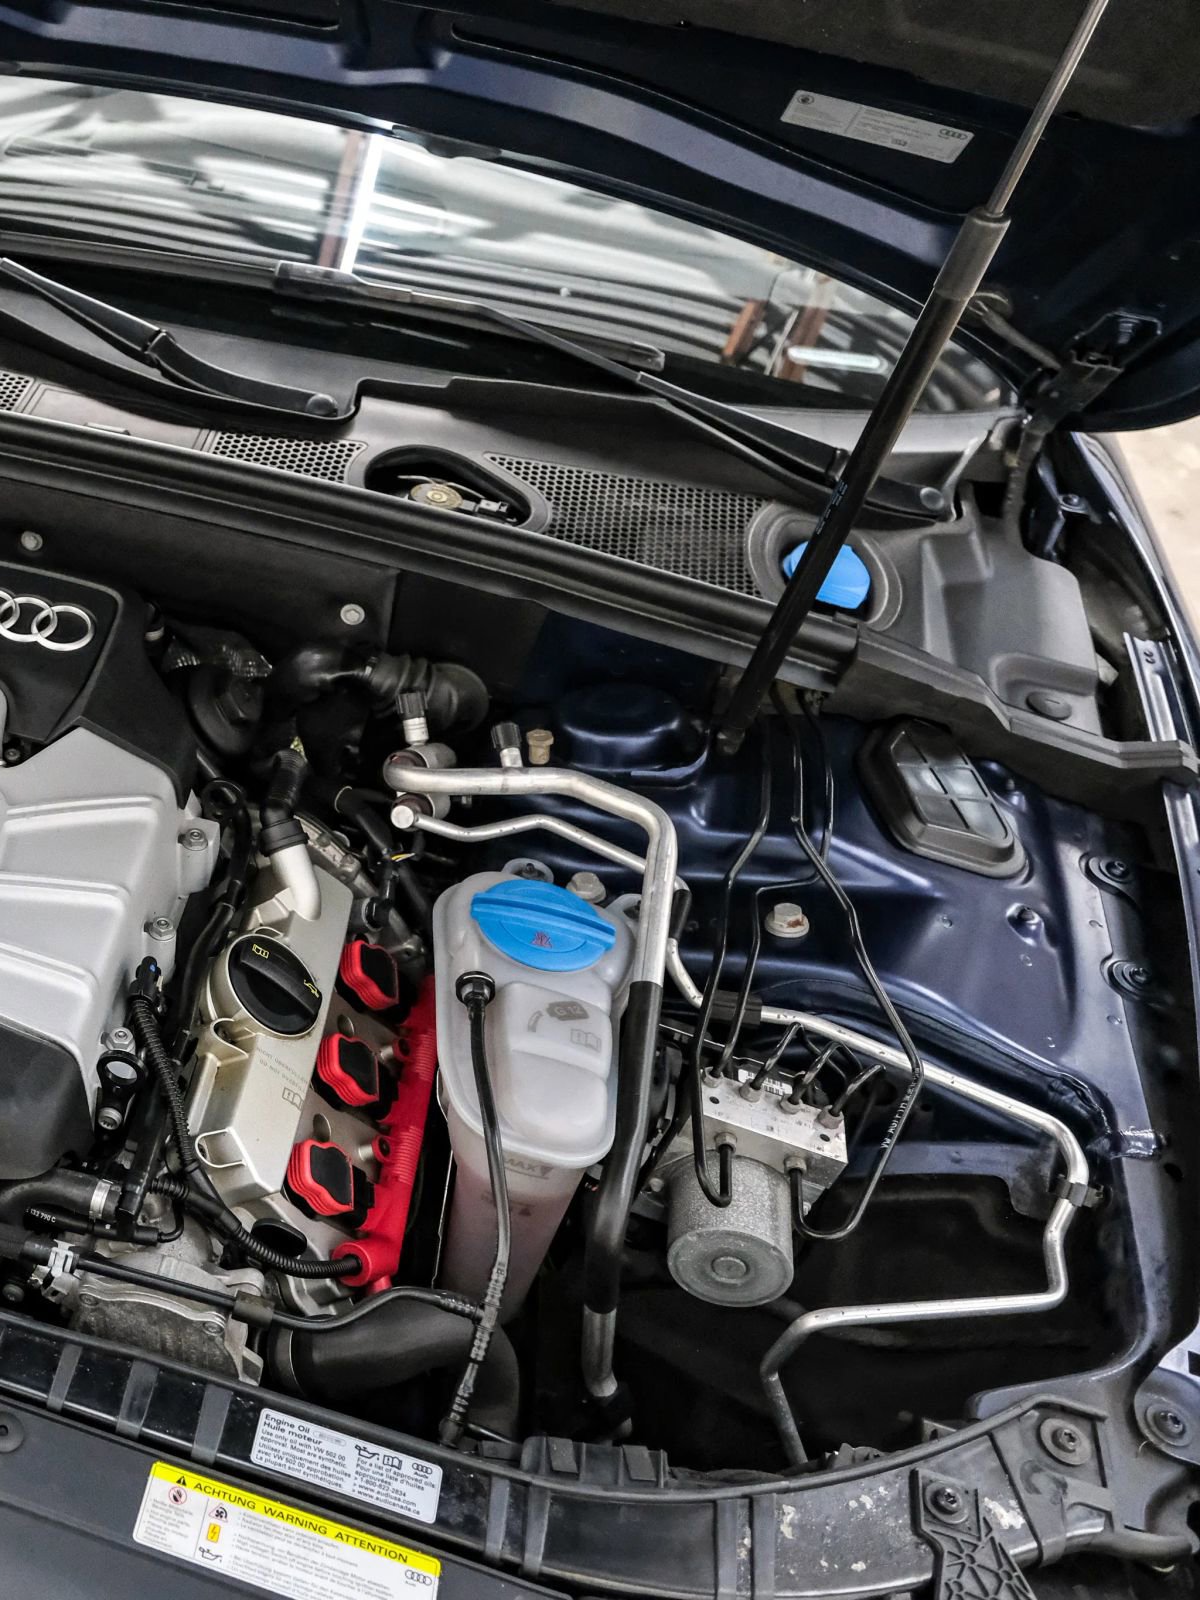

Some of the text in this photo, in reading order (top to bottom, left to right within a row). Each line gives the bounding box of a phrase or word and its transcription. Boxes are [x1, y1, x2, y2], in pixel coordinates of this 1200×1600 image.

[263, 1421, 286, 1433] Huile
[288, 1430, 323, 1445] moteur
[265, 1413, 310, 1434] Engine Oil
[261, 1428, 273, 1437] Use
[274, 1434, 287, 1444] only
[289, 1437, 298, 1445] oil
[298, 1440, 312, 1450] with
[313, 1445, 325, 1454] VW
[290, 1444, 305, 1454] Most
[257, 1449, 272, 1457] avec
[273, 1452, 285, 1461] VW
[264, 1458, 287, 1469] plupart
[288, 1465, 302, 1474] sont
[282, 1449, 319, 1467] uniquement
[320, 1462, 331, 1471] des
[333, 1466, 351, 1478] huiles
[356, 1463, 424, 1491] Pour une liste d'huiles
[357, 1457, 368, 1465] For
[374, 1463, 384, 1471] list
[393, 1469, 423, 1484] approved
[424, 1480, 435, 1489] oils
[357, 1490, 420, 1515] www.audicanada.ca
[194, 1482, 256, 1510] ACHTUNG
[264, 1505, 327, 1535] WARNING
[335, 1532, 408, 1563] ATTENTION
